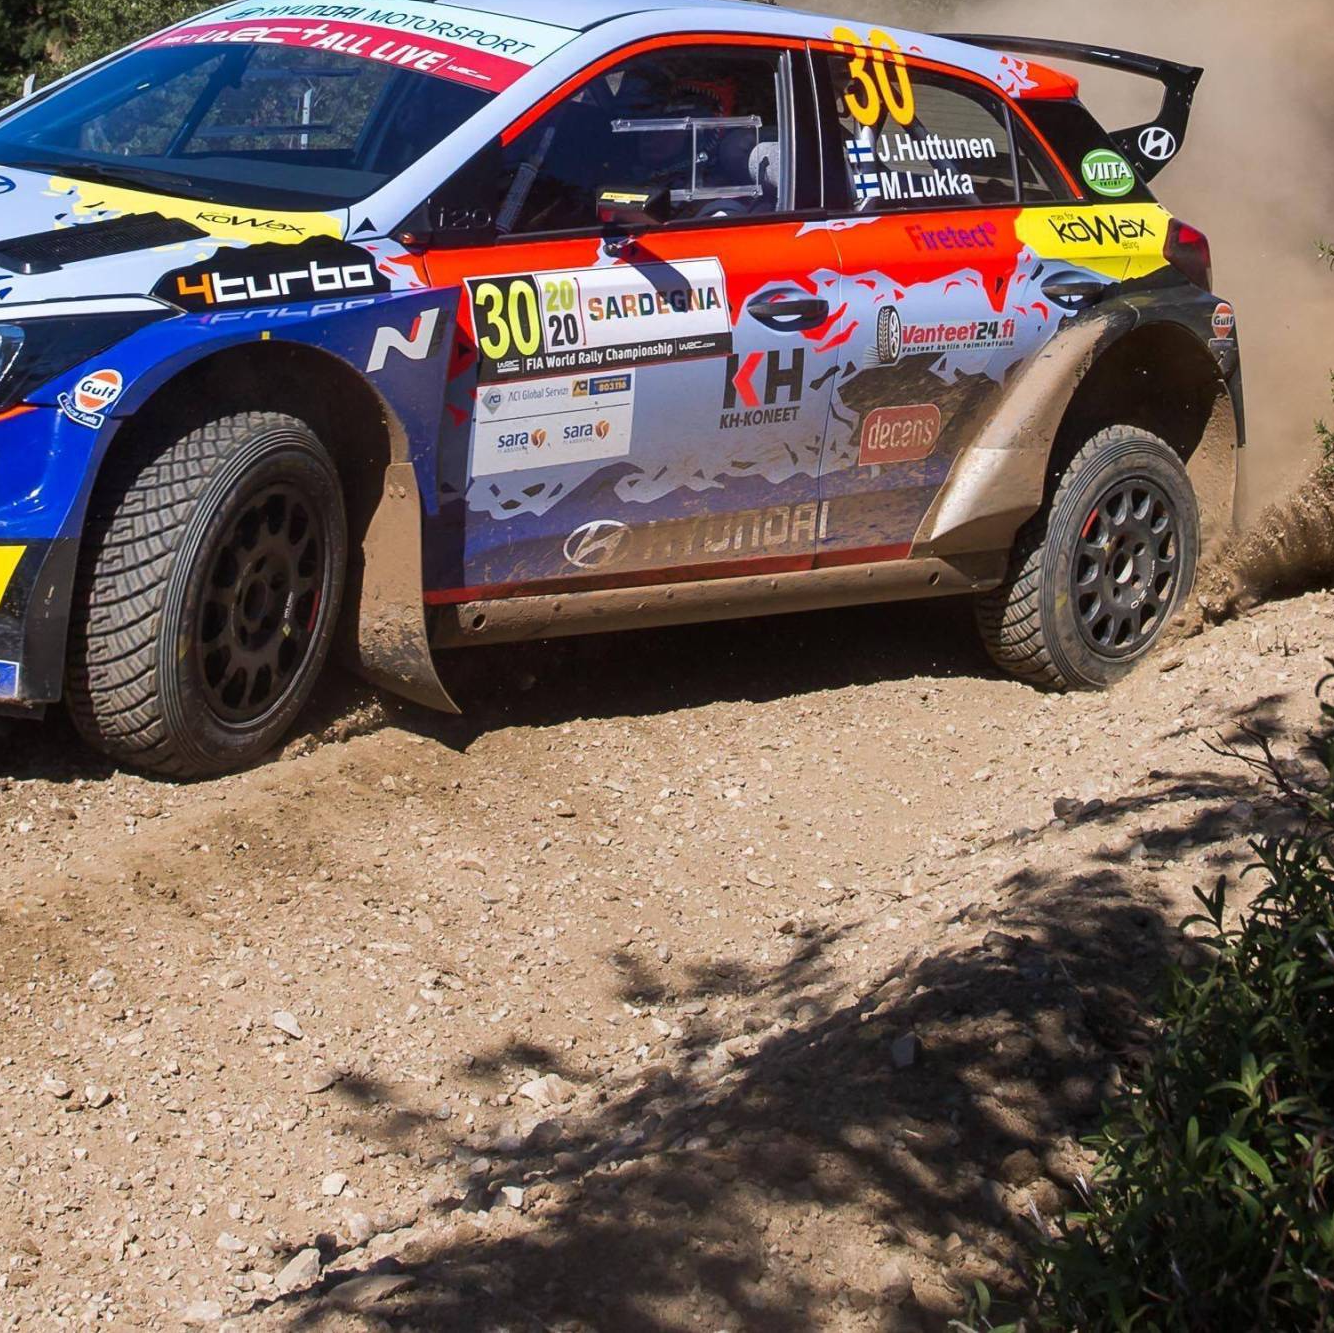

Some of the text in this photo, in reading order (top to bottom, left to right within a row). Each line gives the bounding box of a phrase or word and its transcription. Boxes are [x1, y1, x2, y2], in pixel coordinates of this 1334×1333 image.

[263, 5, 535, 55] HYUNDAI MOTORSPORT
[312, 31, 372, 55] ALL
[370, 40, 448, 71] LIVE
[832, 26, 915, 126] 30
[878, 133, 997, 162] J.Huttunen
[880, 168, 974, 200] M.Lukka
[1082, 162, 1132, 181] VIITA
[904, 222, 993, 251] Firetect
[177, 261, 374, 304] 4turbo
[545, 280, 574, 311] 20
[588, 287, 722, 321] SARDEGNA
[475, 280, 541, 359] 30
[549, 313, 579, 347] 20
[902, 318, 1016, 344] Vanteet24.fi
[1214, 316, 1235, 325] Gulf
[526, 357, 544, 371] FIA
[547, 353, 576, 367] World
[578, 350, 603, 365] Rally
[606, 342, 673, 361] Championship
[81, 380, 117, 399] Gulf
[723, 347, 804, 409] KH
[522, 388, 544, 400] Global
[563, 423, 593, 439] sara
[719, 406, 800, 429] KH-KONEET
[497, 431, 529, 448] sara
[868, 416, 935, 451] decens
